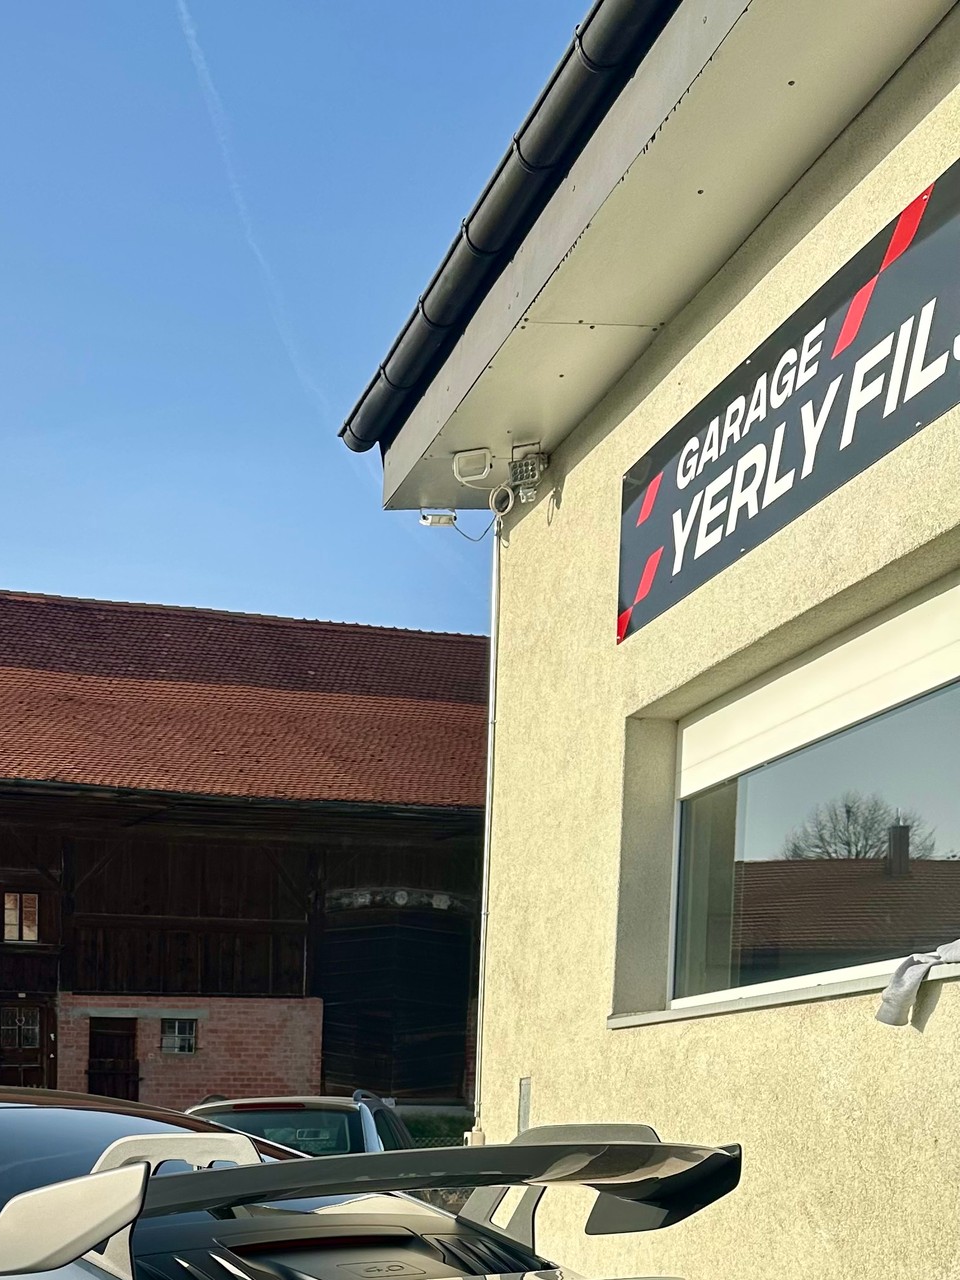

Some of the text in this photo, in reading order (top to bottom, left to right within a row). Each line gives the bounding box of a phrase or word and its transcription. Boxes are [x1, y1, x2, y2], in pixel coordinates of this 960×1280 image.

[671, 296, 960, 577] YERLY FIL
[676, 317, 828, 490] GARAGE
